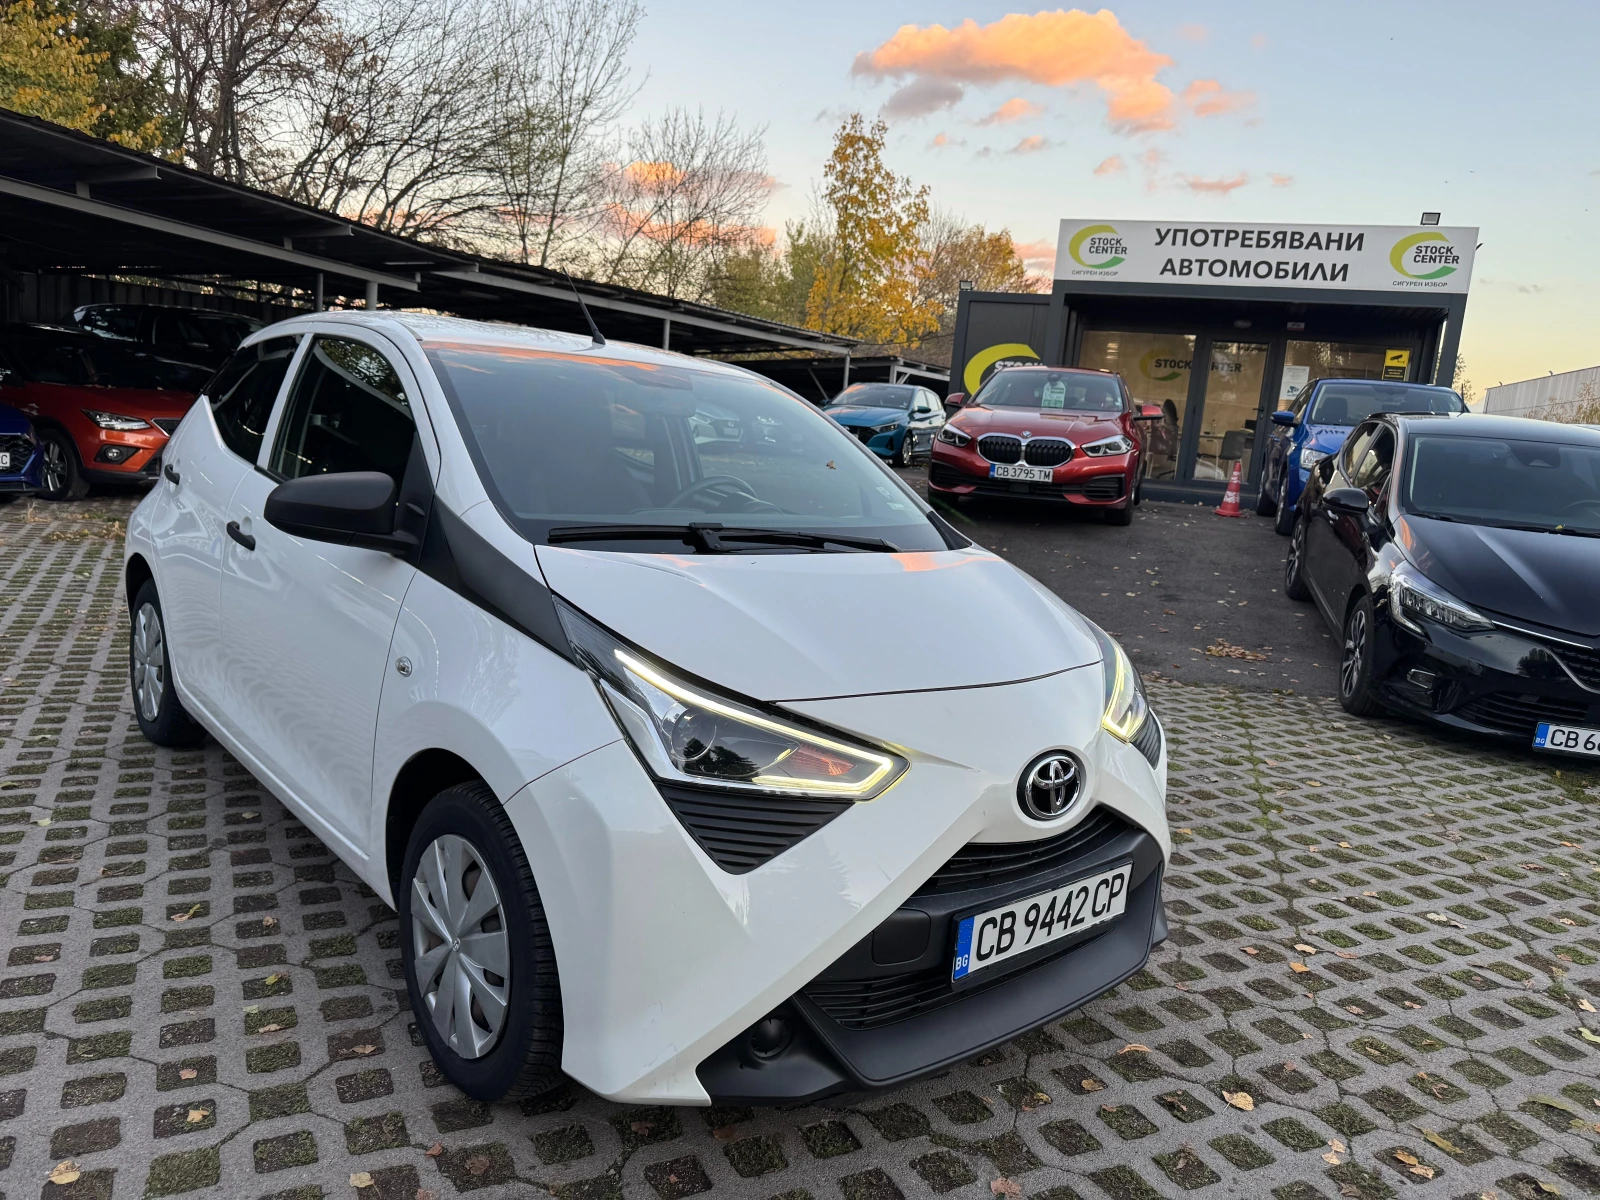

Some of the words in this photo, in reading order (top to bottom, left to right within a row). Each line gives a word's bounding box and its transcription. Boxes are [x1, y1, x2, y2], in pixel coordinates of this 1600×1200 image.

[1090, 237, 1123, 246] STOCK
[1154, 228, 1365, 252] УПОТРЕБЯВАНИ
[1089, 246, 1127, 254] CENTER
[1415, 245, 1455, 255] STOCK
[1413, 254, 1460, 264] CENTER
[1159, 258, 1349, 282] АВТОМОБИЛИ
[1154, 358, 1192, 370] STOCK
[1211, 361, 1242, 373] NTER
[996, 466, 1009, 477] CB
[1011, 467, 1035, 479] 3795
[1037, 469, 1051, 480] TM
[1550, 728, 1580, 749] CB
[1583, 733, 1600, 752] 6
[976, 910, 1017, 962] CB
[1024, 885, 1090, 945] 9442
[1091, 872, 1125, 918] CP
[955, 954, 969, 971] BG
